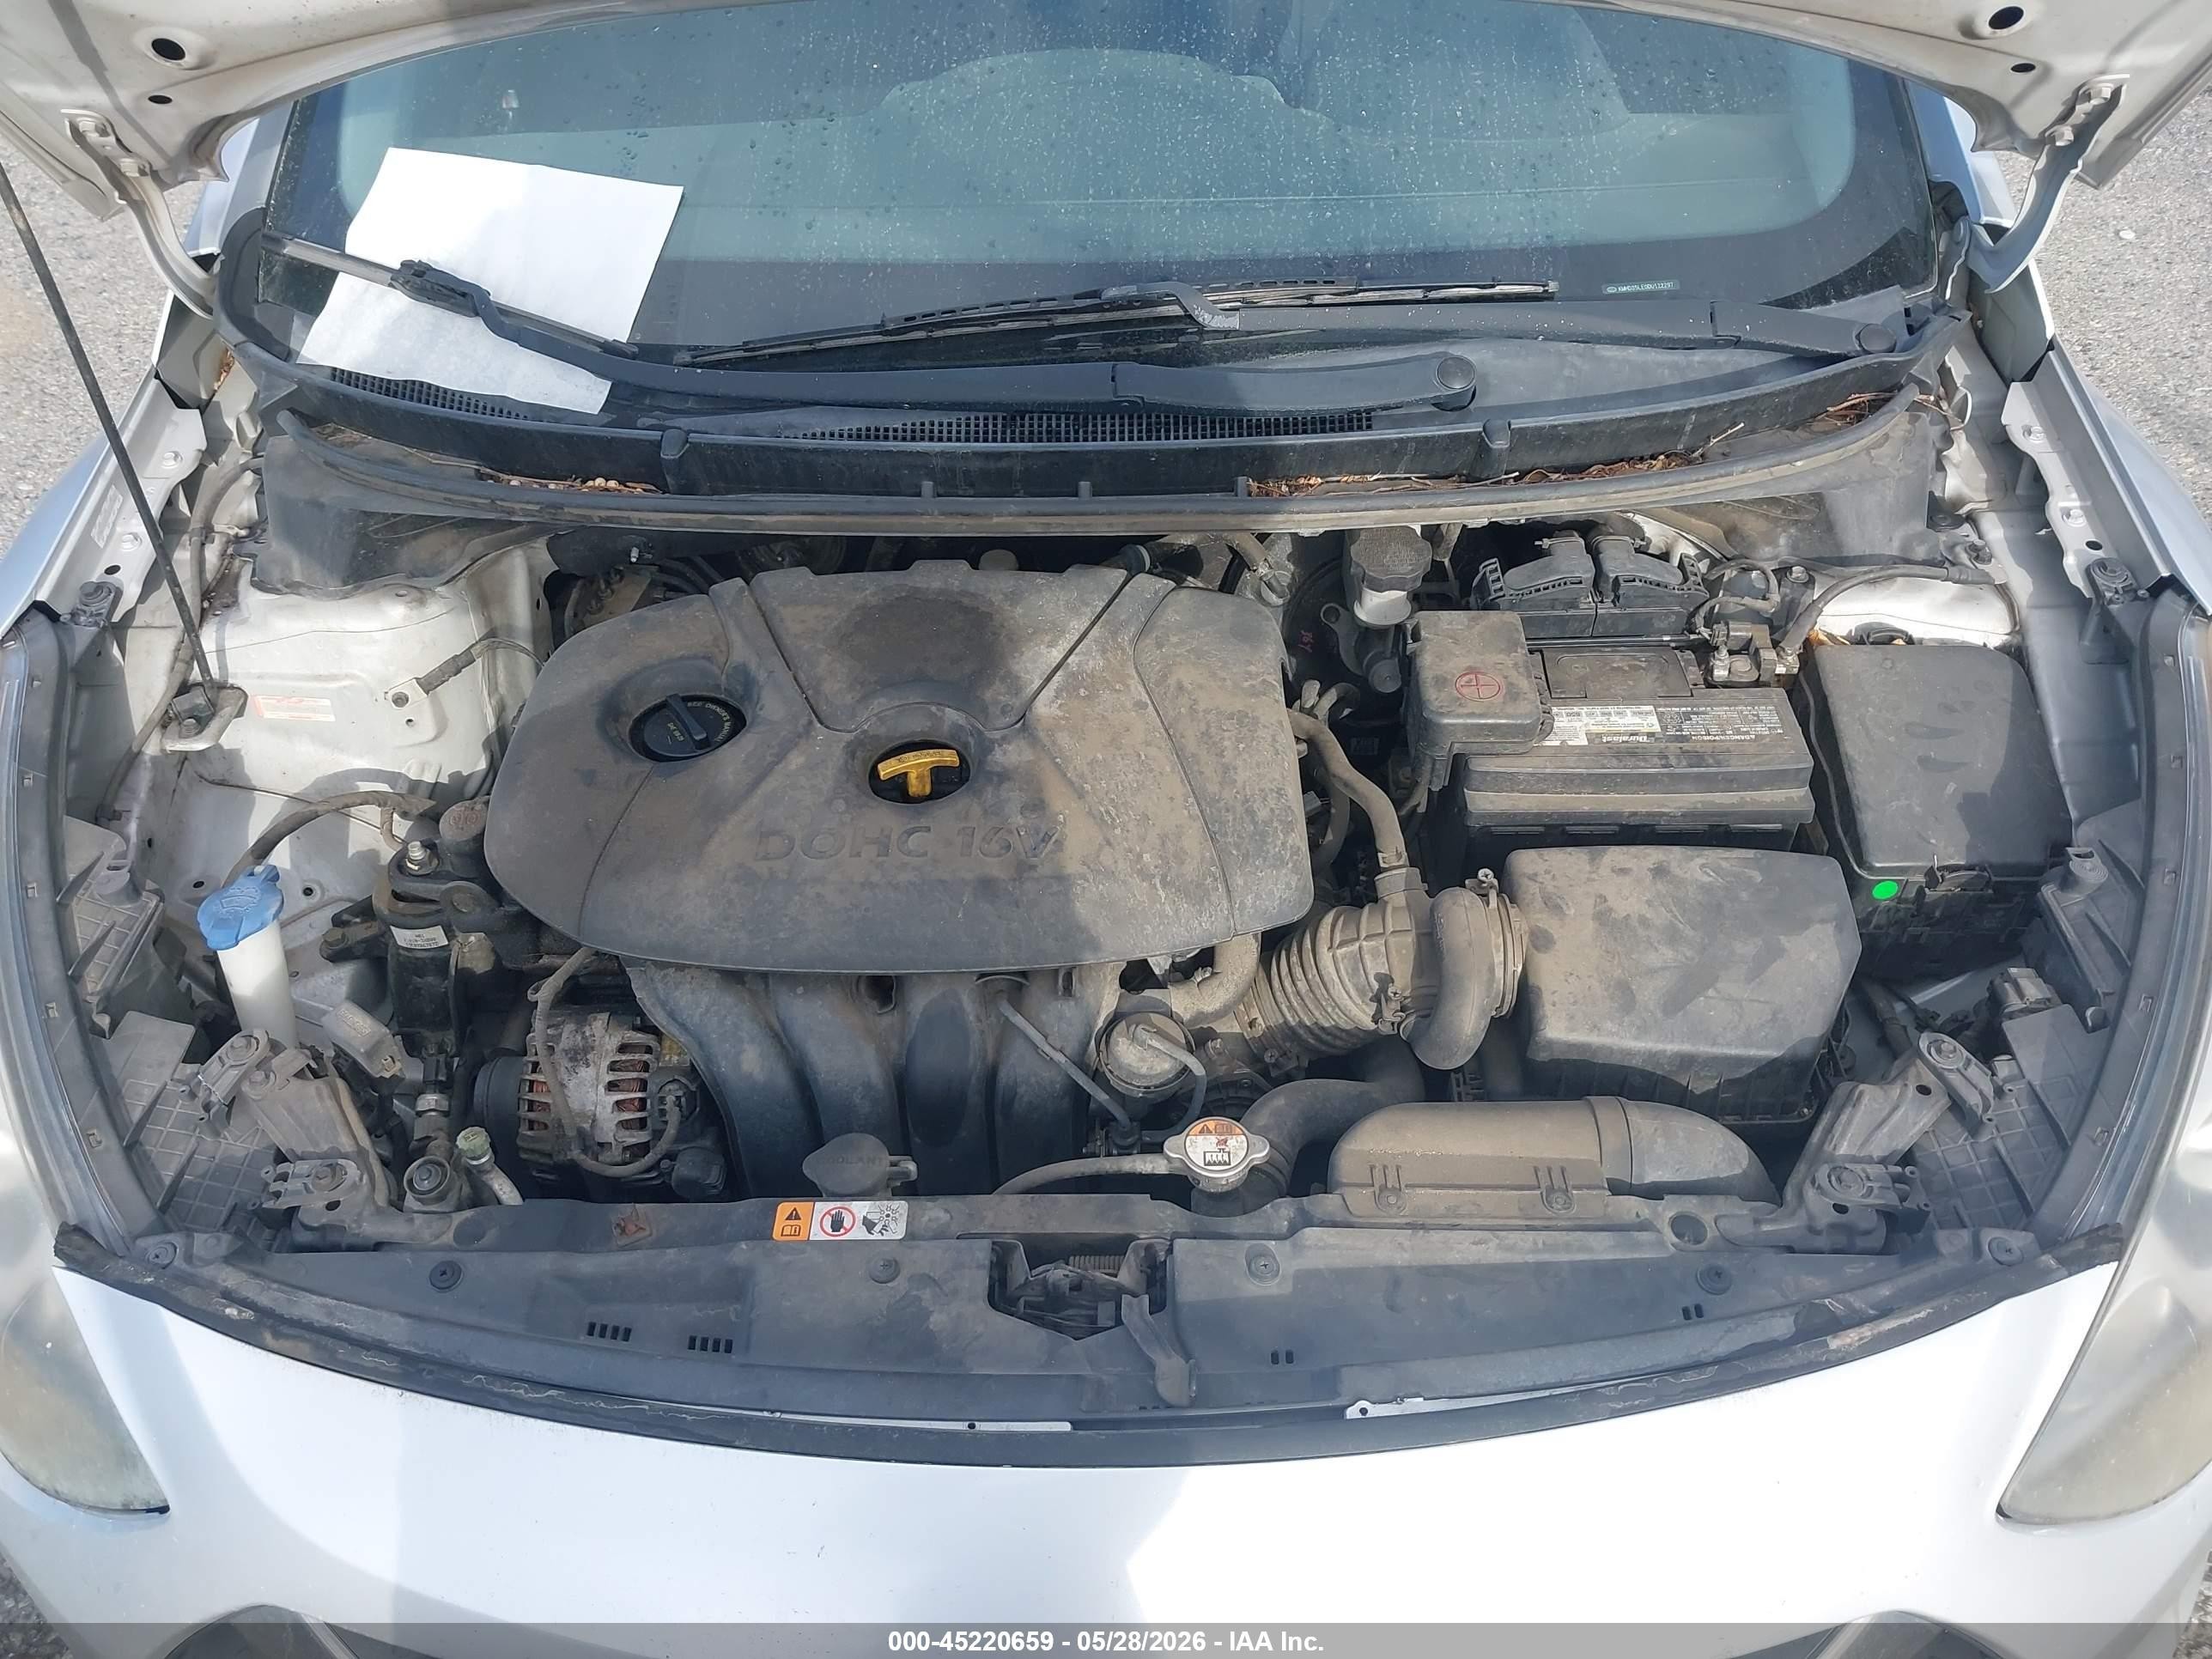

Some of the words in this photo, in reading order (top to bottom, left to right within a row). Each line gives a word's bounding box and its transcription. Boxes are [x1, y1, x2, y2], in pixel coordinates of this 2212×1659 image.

[1602, 733, 1648, 743] Duralast
[755, 823, 932, 860] DOHC
[956, 825, 1061, 859] 16V
